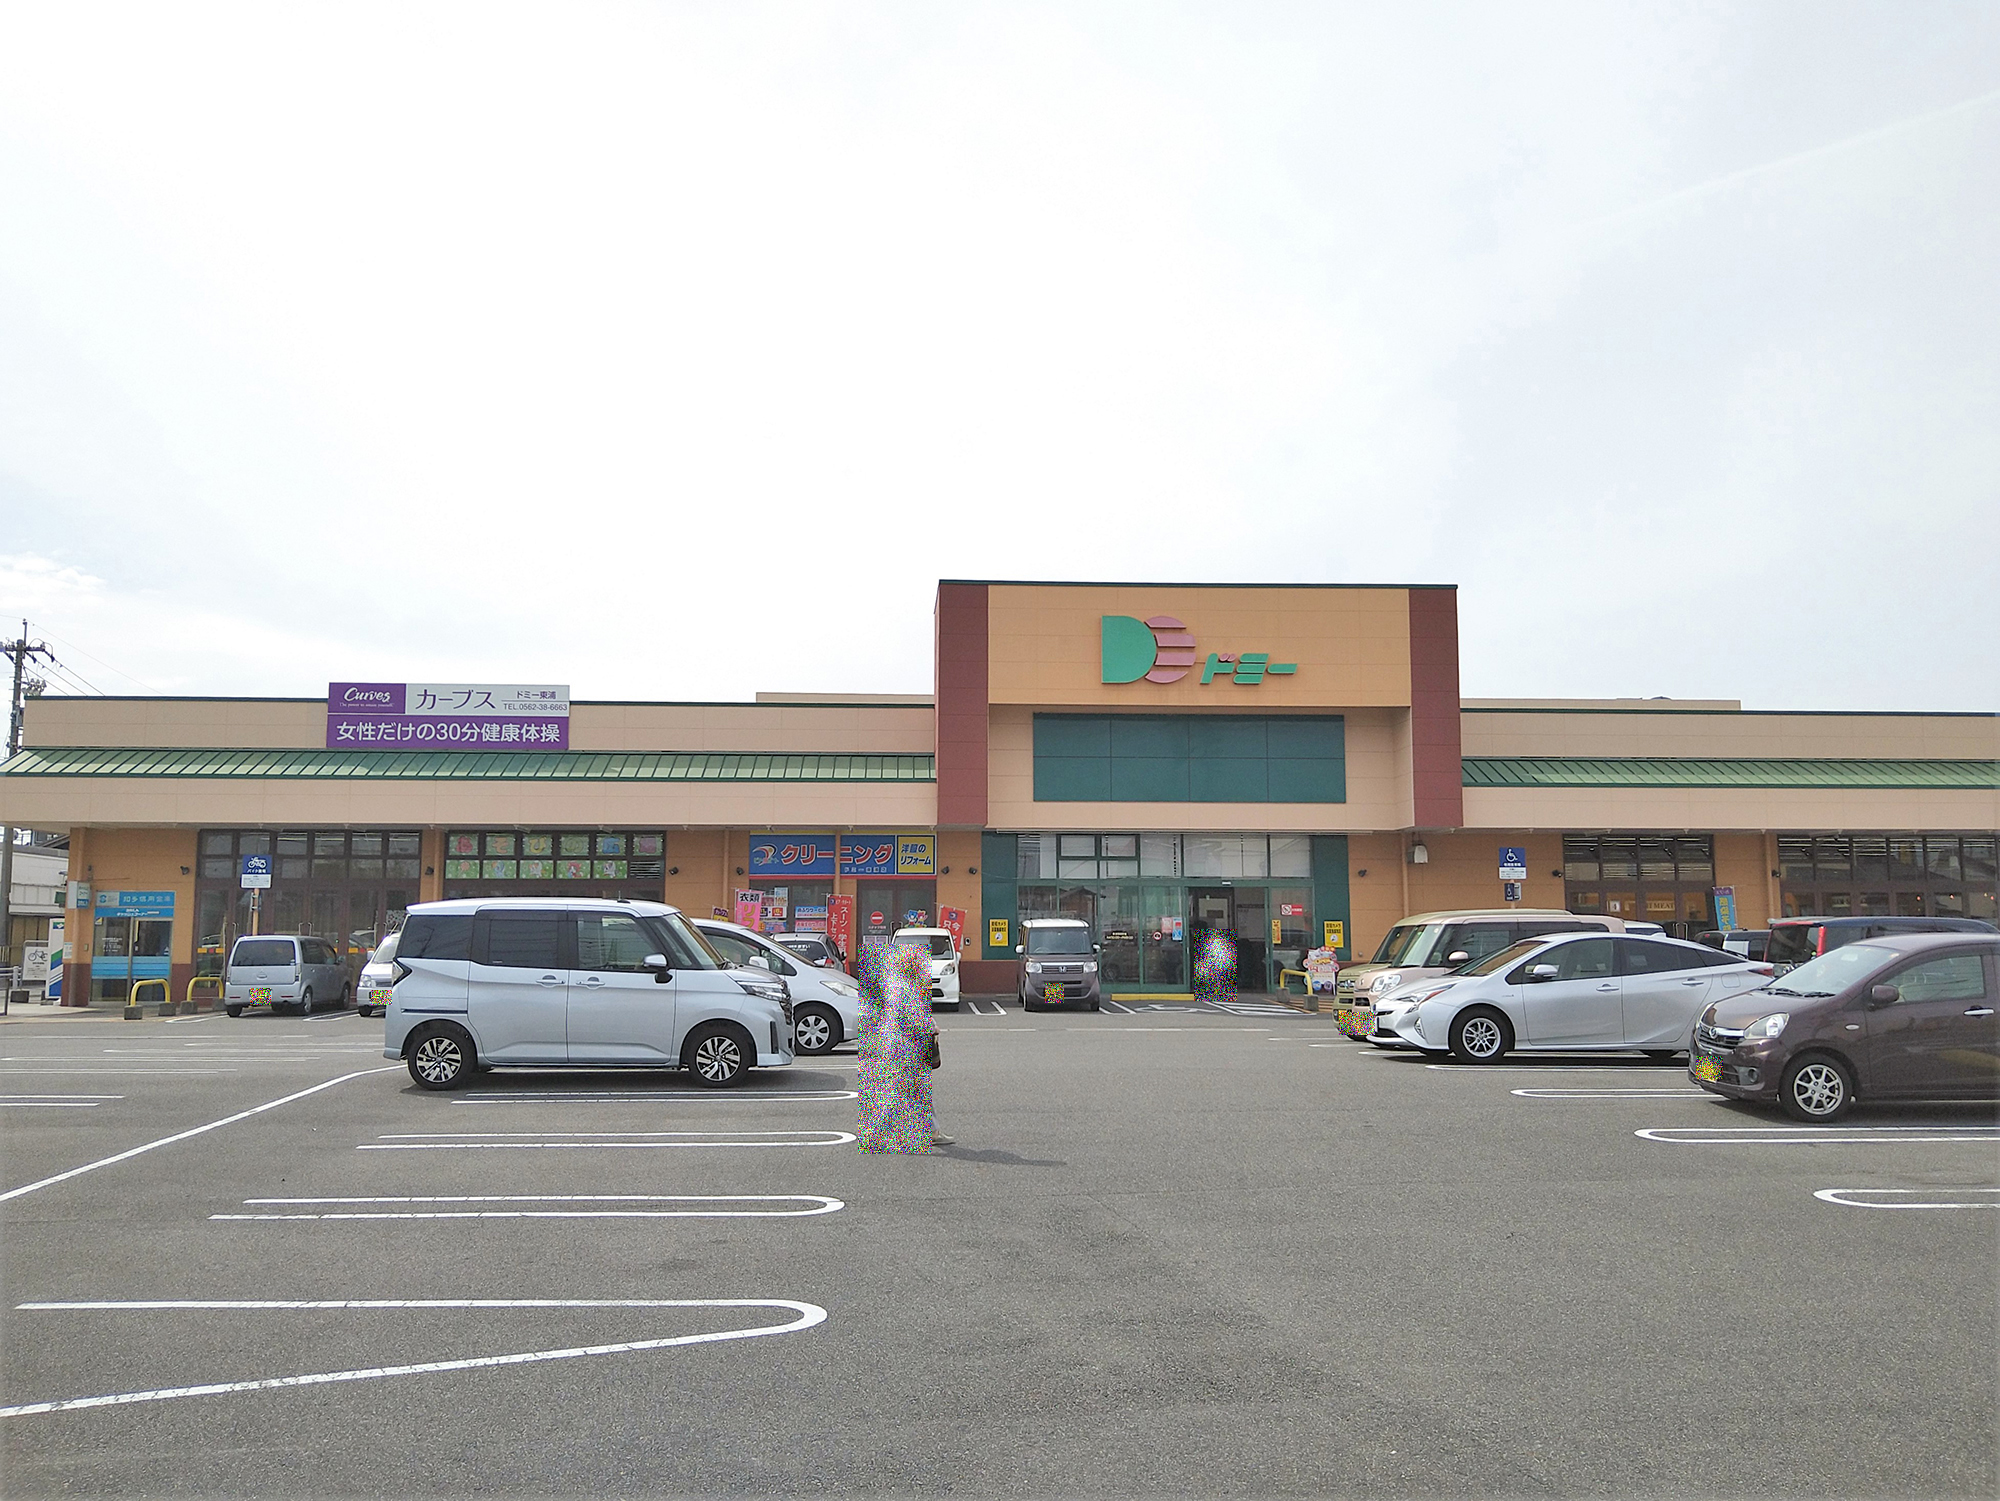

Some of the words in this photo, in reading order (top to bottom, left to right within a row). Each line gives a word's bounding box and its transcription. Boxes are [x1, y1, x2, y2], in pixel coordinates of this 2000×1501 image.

[1199, 652, 1298, 685] ドミー
[343, 686, 391, 703] Curves
[415, 689, 496, 710] カーブス
[516, 690, 557, 700] ドミー東浦
[336, 721, 561, 743] 女性だけの30分健康体操
[780, 843, 894, 865] クリーニング
[900, 855, 931, 865] リフォーム
[739, 892, 760, 903] 衣類
